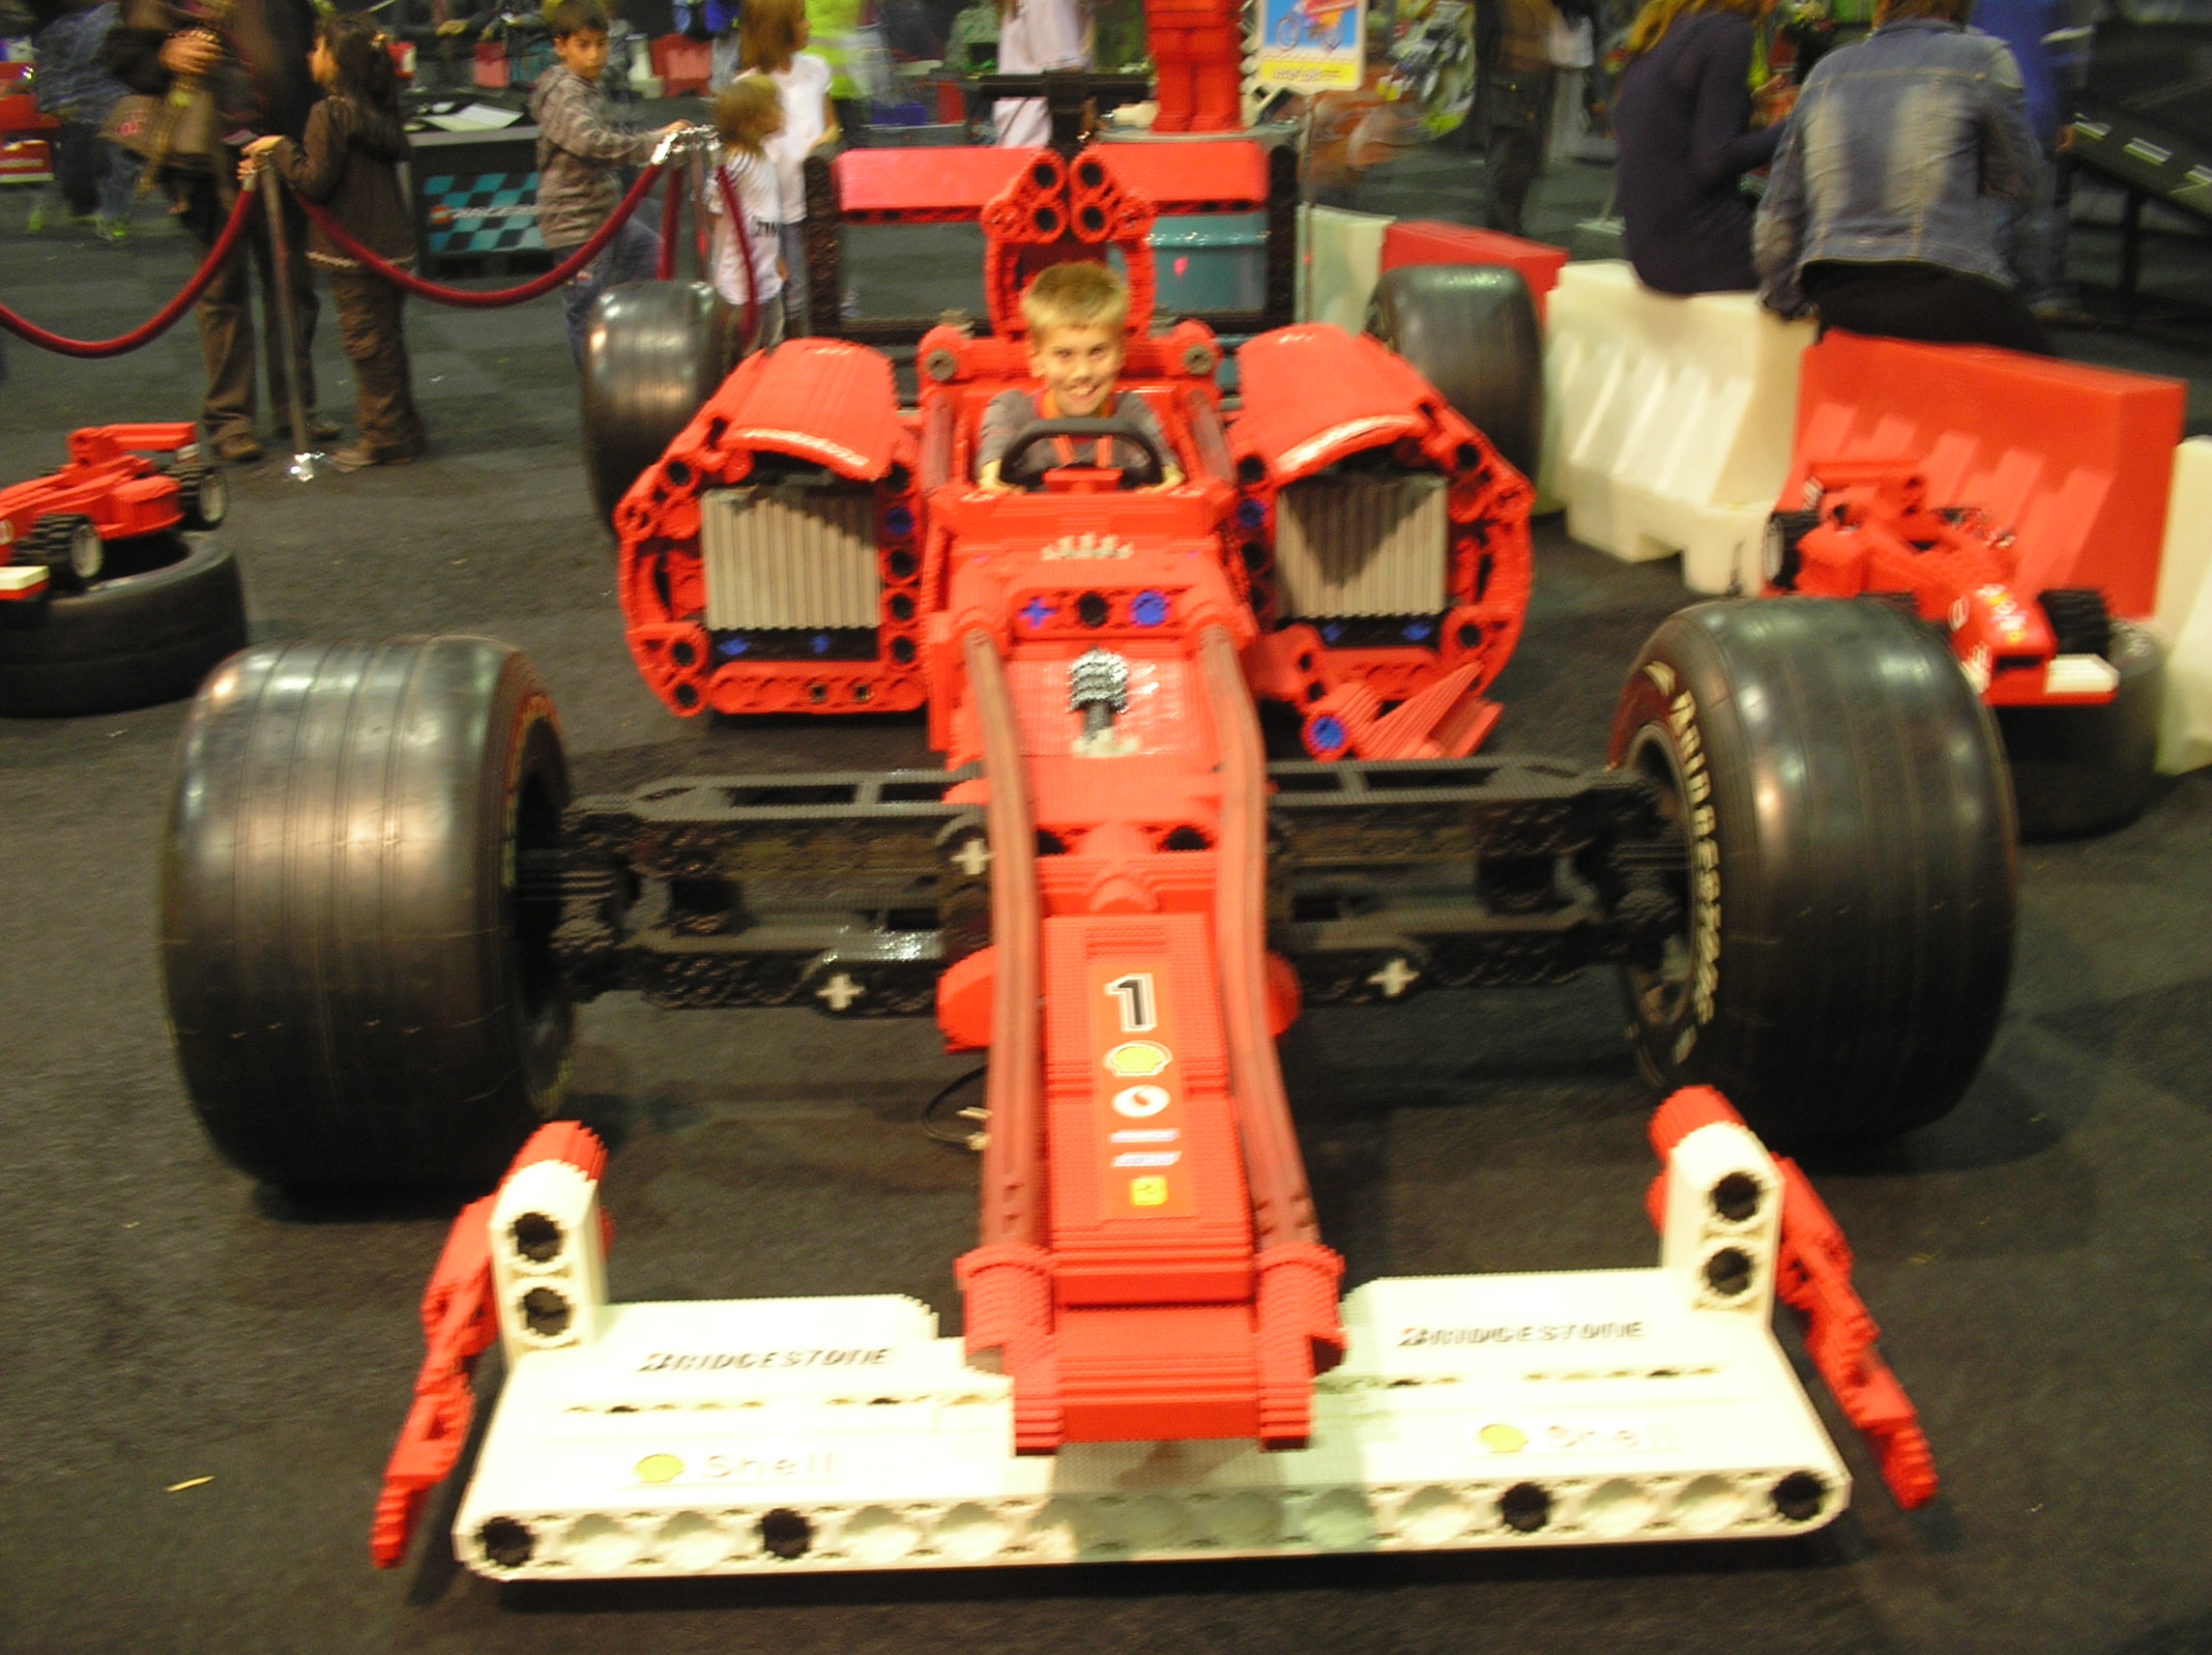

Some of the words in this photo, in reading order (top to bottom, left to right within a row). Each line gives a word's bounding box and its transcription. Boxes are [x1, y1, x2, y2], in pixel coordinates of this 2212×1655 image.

[1104, 973, 1158, 1031] 1
[1397, 1321, 1644, 1348] BRIDGESTONE
[636, 1347, 891, 1373] BRIDGESTONE
[703, 1452, 837, 1480] Shell
